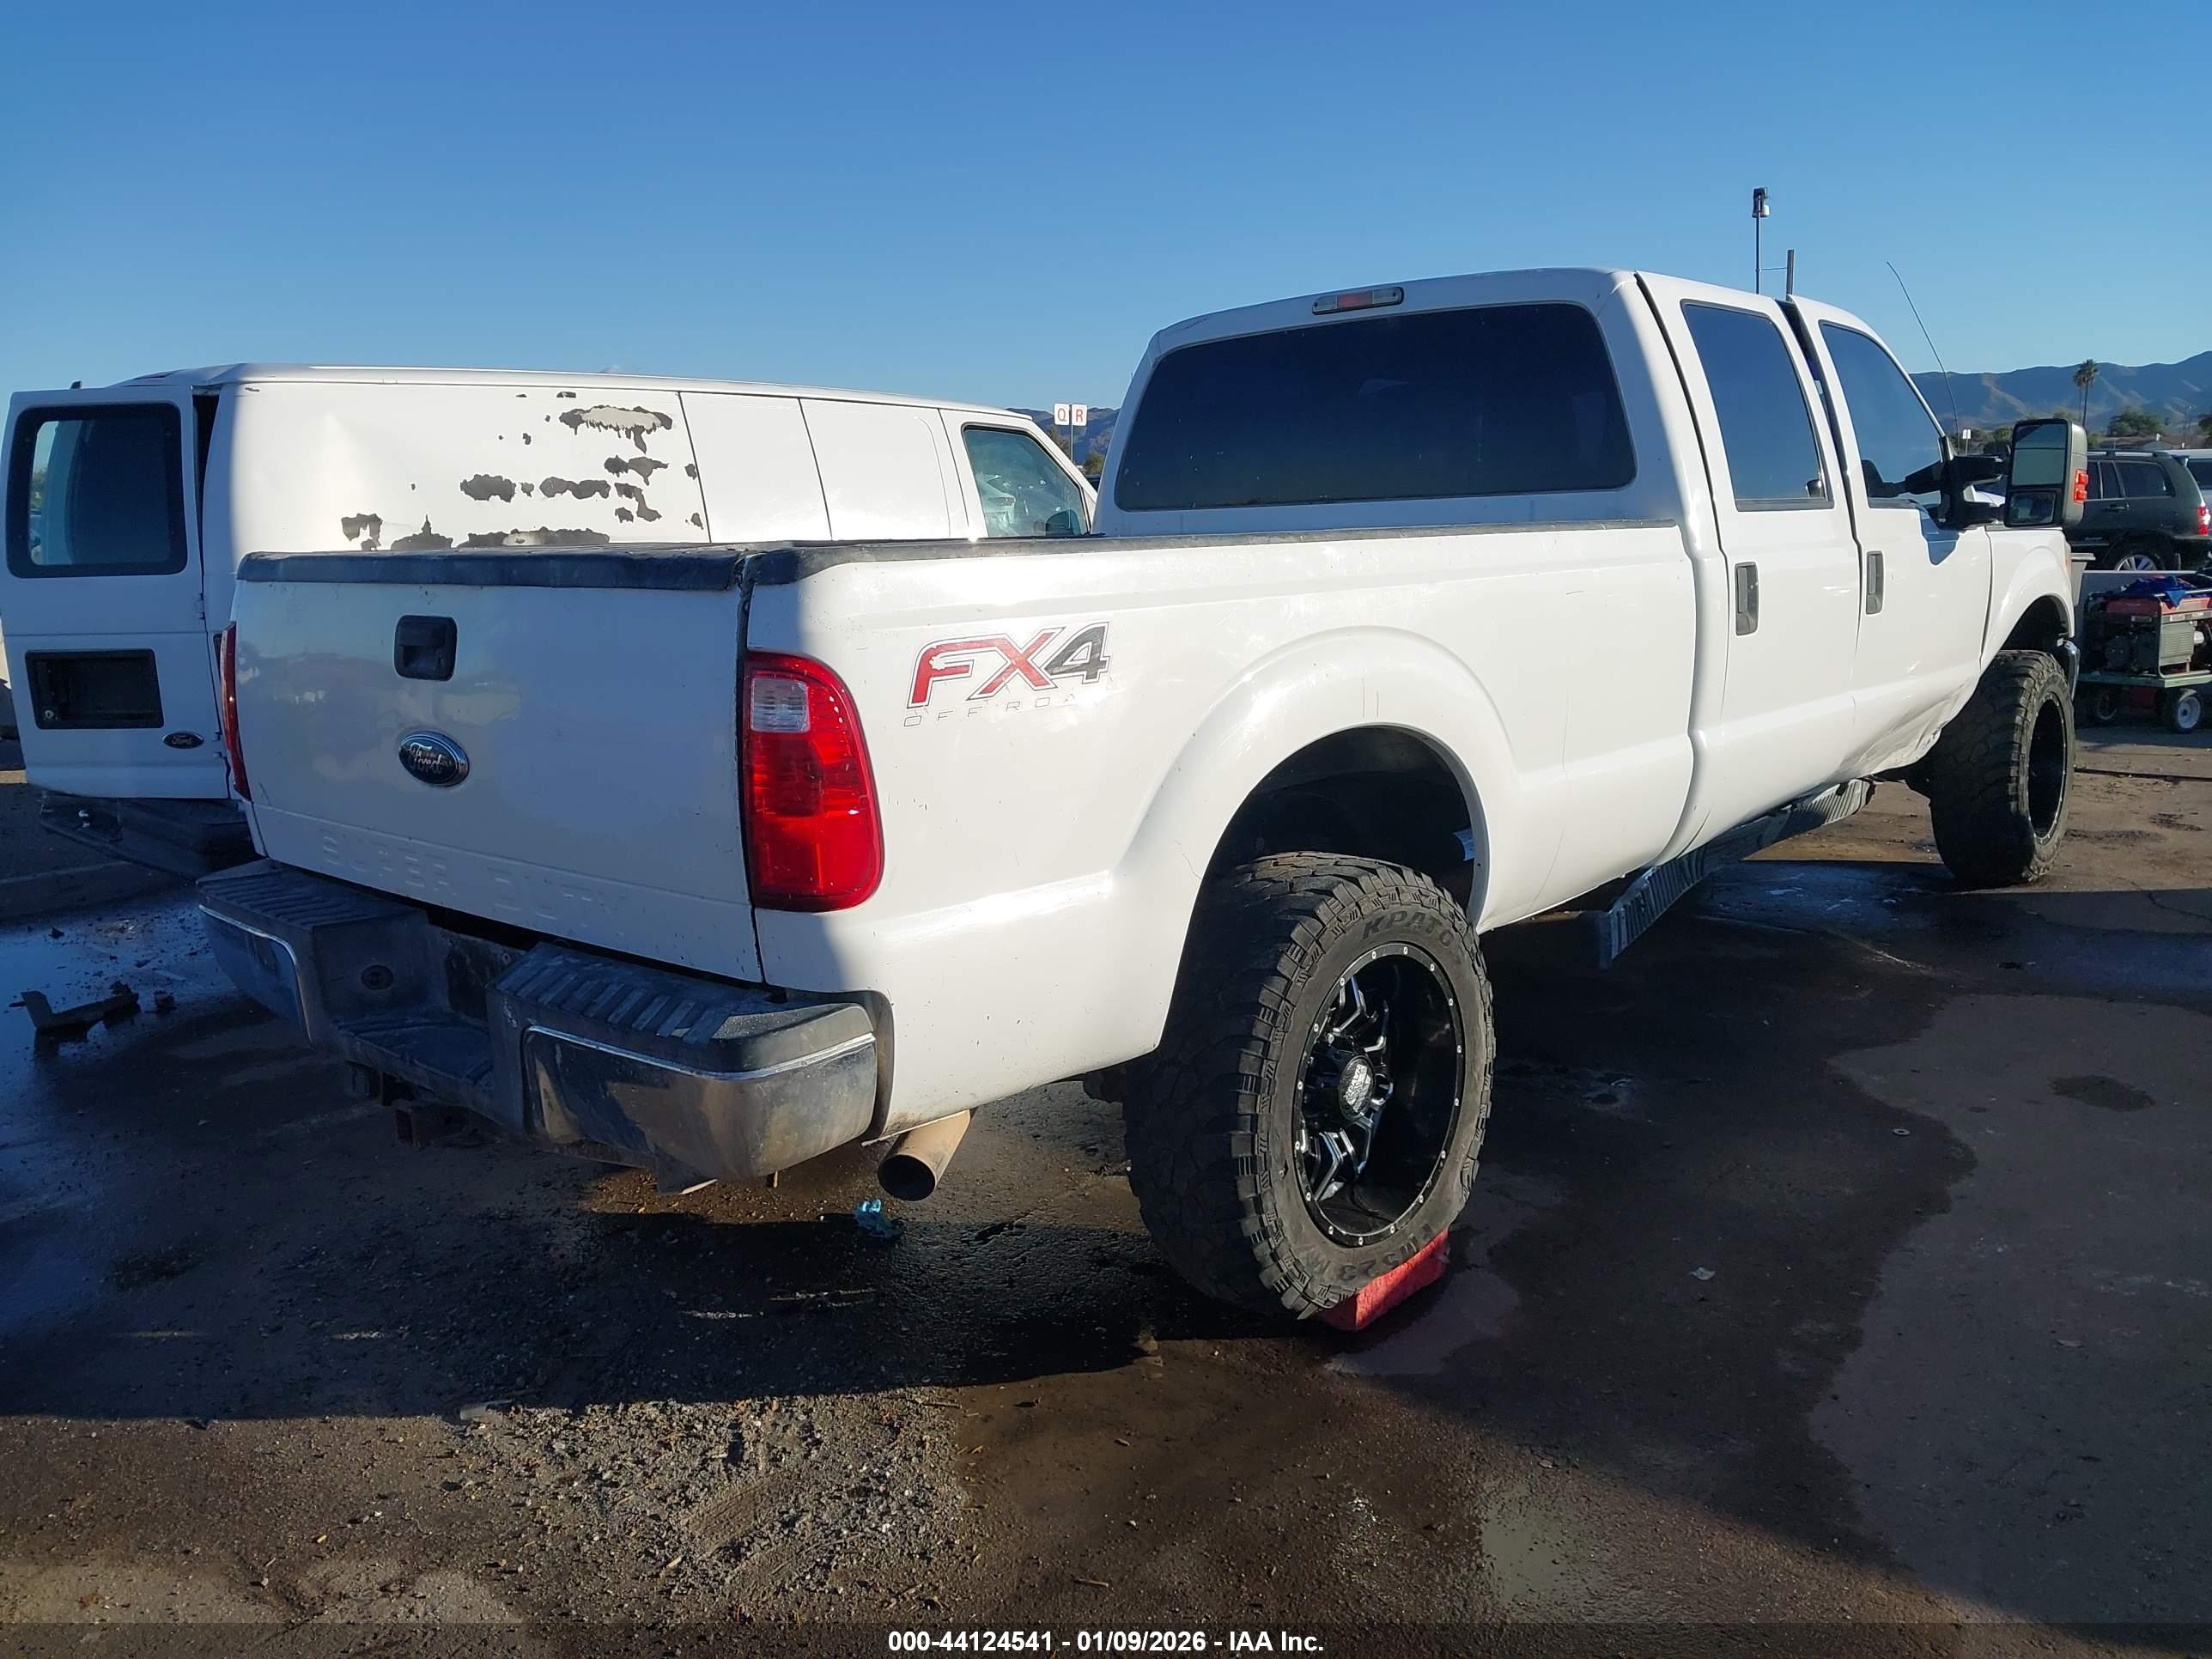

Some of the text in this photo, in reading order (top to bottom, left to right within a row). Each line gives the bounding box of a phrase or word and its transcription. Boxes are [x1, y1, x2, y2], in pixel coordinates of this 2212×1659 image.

[1057, 408, 1067, 422] Q
[1075, 409, 1084, 422] R
[906, 622, 1110, 709] FX4
[903, 706, 984, 727] OFF
